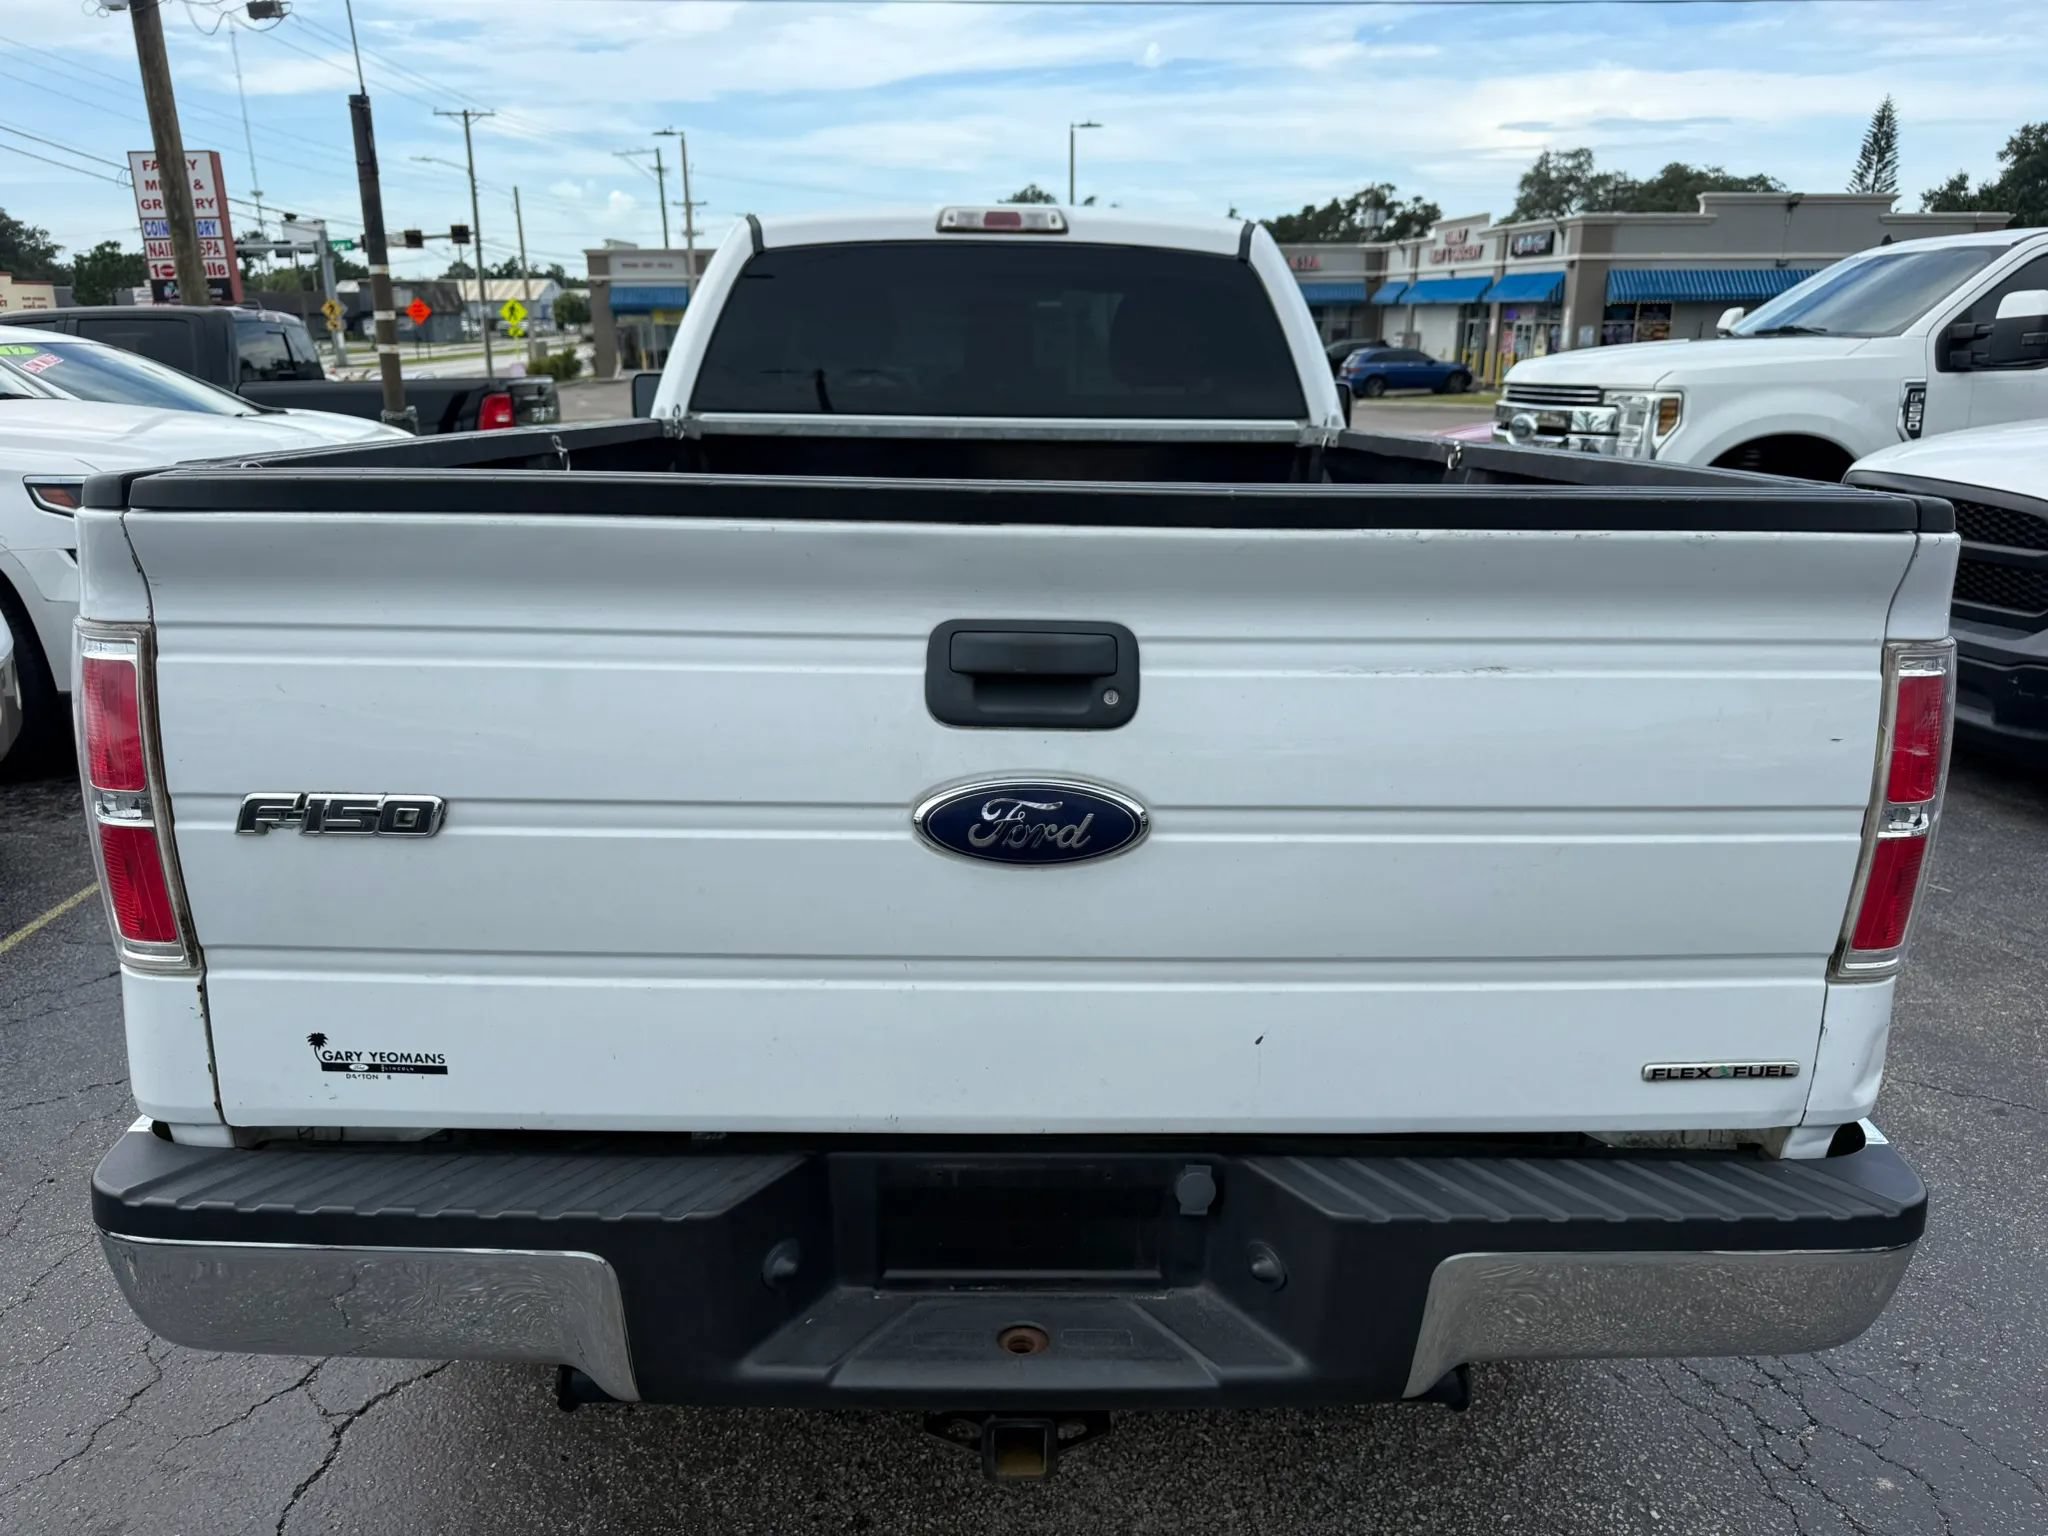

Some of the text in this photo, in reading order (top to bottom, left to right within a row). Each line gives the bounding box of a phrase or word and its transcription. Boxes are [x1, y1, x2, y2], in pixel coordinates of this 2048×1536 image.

[142, 159, 197, 171] FAY
[140, 198, 215, 211] GRRY
[236, 792, 447, 837] F-150
[967, 797, 1095, 850] Ford
[321, 1049, 446, 1065] GARY YEOMANS
[1651, 1065, 1795, 1080] FLEX FUEL
